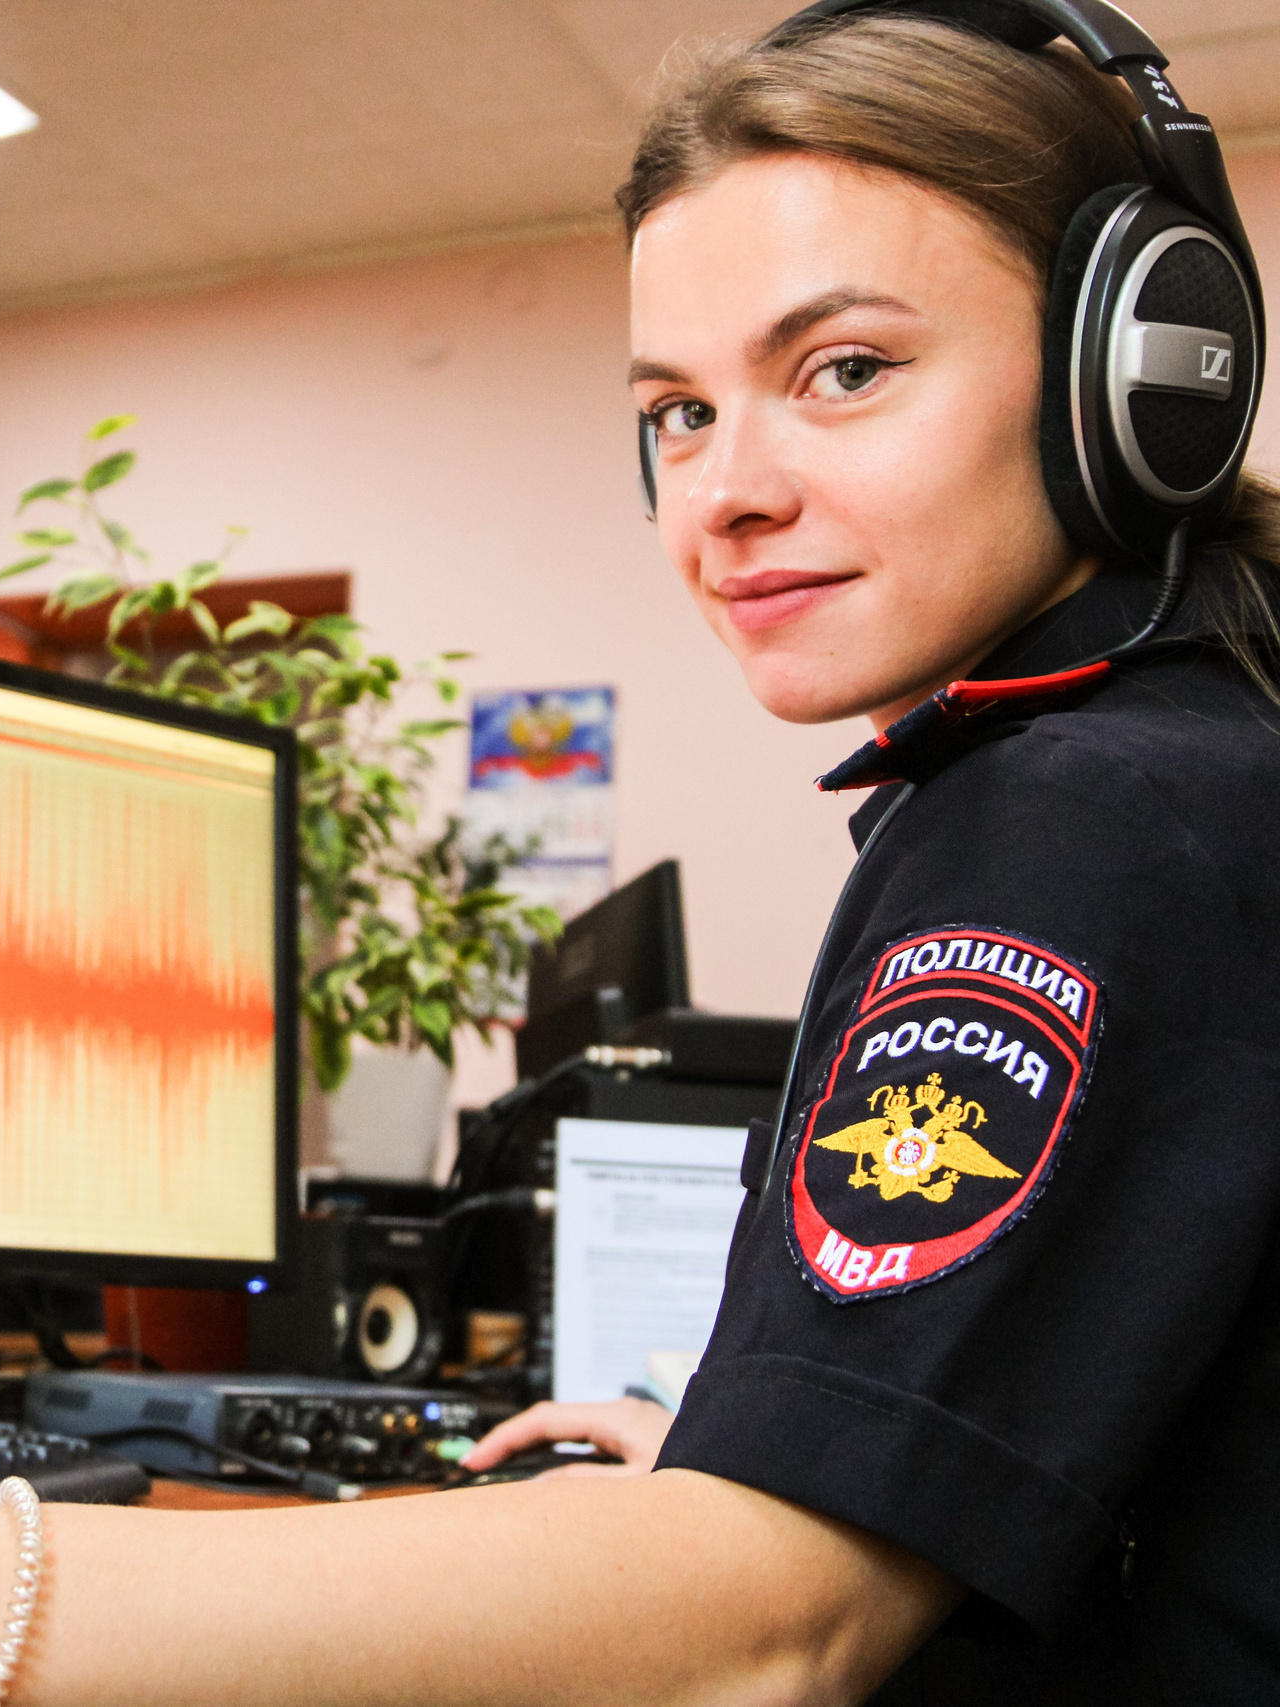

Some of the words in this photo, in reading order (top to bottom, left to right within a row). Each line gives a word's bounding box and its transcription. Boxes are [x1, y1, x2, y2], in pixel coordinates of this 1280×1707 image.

[1164, 122, 1213, 132] SENNHEISER
[880, 938, 1087, 1021] ПОЛИЦИЯ
[857, 1016, 1050, 1100] РОССИЯ
[815, 1228, 914, 1289] МВД
